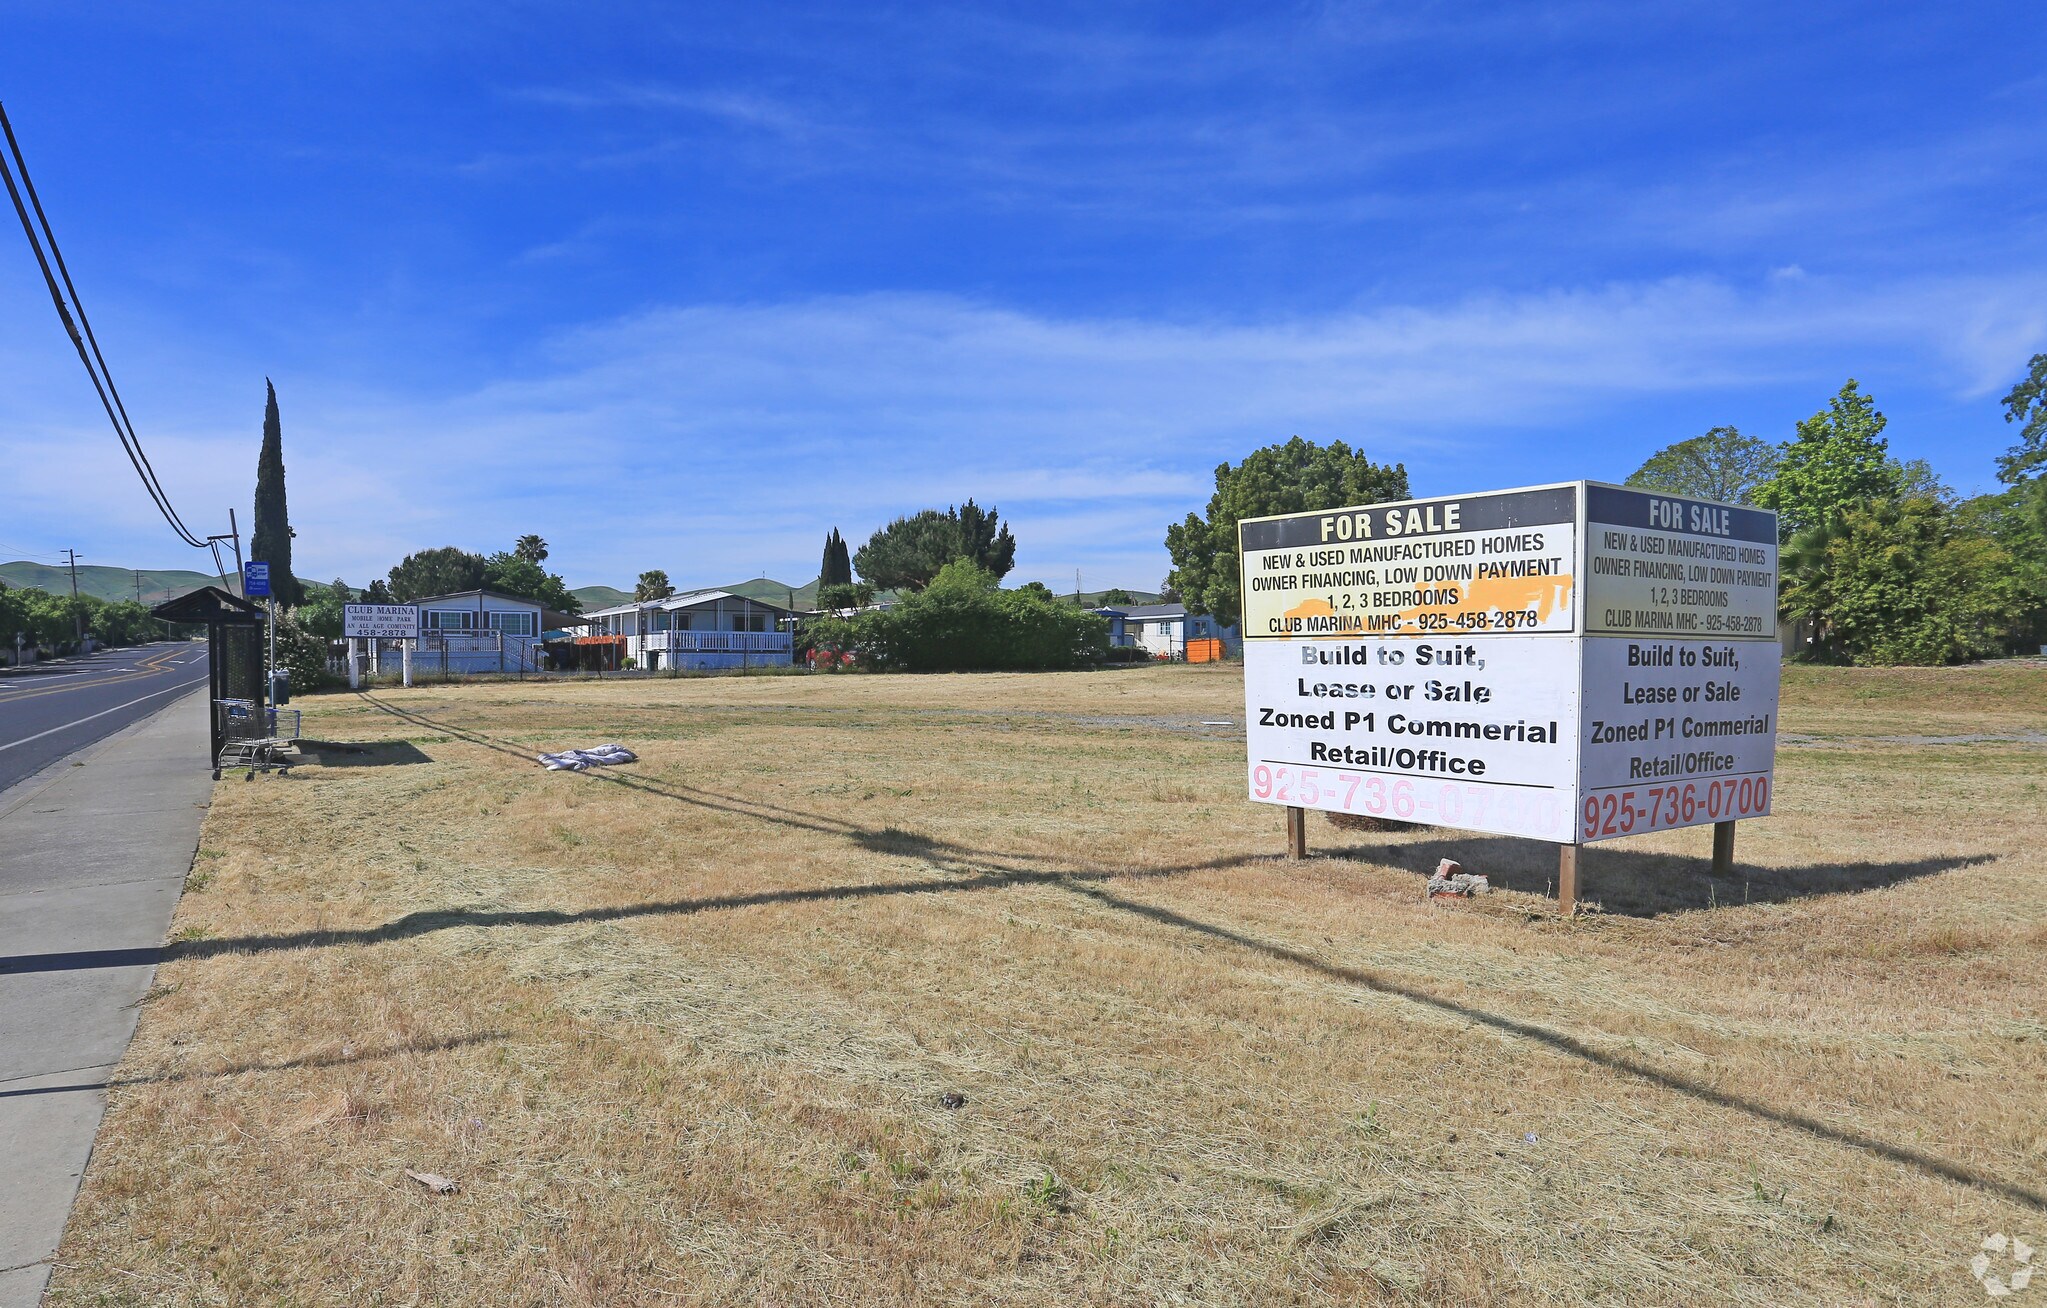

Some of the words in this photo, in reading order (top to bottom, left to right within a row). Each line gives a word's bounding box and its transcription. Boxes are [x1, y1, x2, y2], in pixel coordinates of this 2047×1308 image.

[1321, 515, 1371, 541] FOR
[1386, 504, 1461, 536] SALE
[1650, 499, 1682, 529] FOR
[1691, 505, 1729, 535] SALE
[1263, 554, 1291, 570] NEW
[1296, 554, 1305, 568] &
[1310, 551, 1344, 566] USED
[1350, 539, 1475, 563] MANUFACTURED
[1481, 533, 1544, 554] HOMES
[1604, 532, 1627, 550] NEW
[1630, 535, 1637, 552] &
[1641, 536, 1664, 554] USED
[1668, 539, 1736, 562] MANUFACTURED
[1739, 549, 1765, 565] HOMES
[1252, 575, 1297, 592] OWNER
[1302, 570, 1379, 588] FINANCING,
[1385, 568, 1418, 584] LOW
[1424, 564, 1472, 582] DOWN
[1478, 558, 1561, 579] PAYMENT
[1594, 557, 1630, 576] OWNER
[1634, 560, 1685, 583] FINANCING,
[1689, 565, 1707, 582] LOW
[1711, 567, 1734, 584] DOWN
[1737, 570, 1772, 588] PAYMENT
[1327, 595, 1337, 611] 1,
[1342, 593, 1355, 609] 2,
[1360, 592, 1368, 607] 3
[1373, 588, 1458, 607] BEDROOMS
[1651, 587, 1657, 606] 1,
[1661, 588, 1669, 607] 2,
[1672, 589, 1678, 604] 3
[1681, 589, 1728, 607] BEDROOMS
[1269, 618, 1302, 632] CLUB
[1307, 615, 1362, 631] MARINA
[1368, 615, 1401, 630] MHC
[1418, 611, 1537, 629] 925-458-2878
[1606, 609, 1631, 627] CLUB
[1635, 611, 1673, 629] MARINA
[1676, 613, 1697, 630] MHC
[1707, 615, 1762, 632] 925-458-2878
[1302, 646, 1367, 665] Build
[1377, 647, 1404, 665] to
[1416, 645, 1485, 670] Suit,
[1628, 645, 1673, 667] Build
[1680, 647, 1696, 666] to
[1702, 646, 1738, 671] Suit,
[1298, 678, 1375, 698] Lease
[1386, 683, 1414, 700] or
[1424, 680, 1492, 703] Sale
[1624, 682, 1676, 704] Lease
[1683, 686, 1700, 702] or
[1705, 681, 1740, 701] Sale
[1260, 708, 1334, 729] Zoned
[1345, 712, 1374, 732] P1
[1388, 714, 1557, 744] Commerial
[1591, 720, 1648, 743] Zoned
[1655, 718, 1674, 739] P1
[1682, 715, 1768, 738] Commerial
[1311, 742, 1485, 775] Retail/Office
[1630, 752, 1733, 778] Retail/Office
[1585, 777, 1767, 838] 925-736-0700
